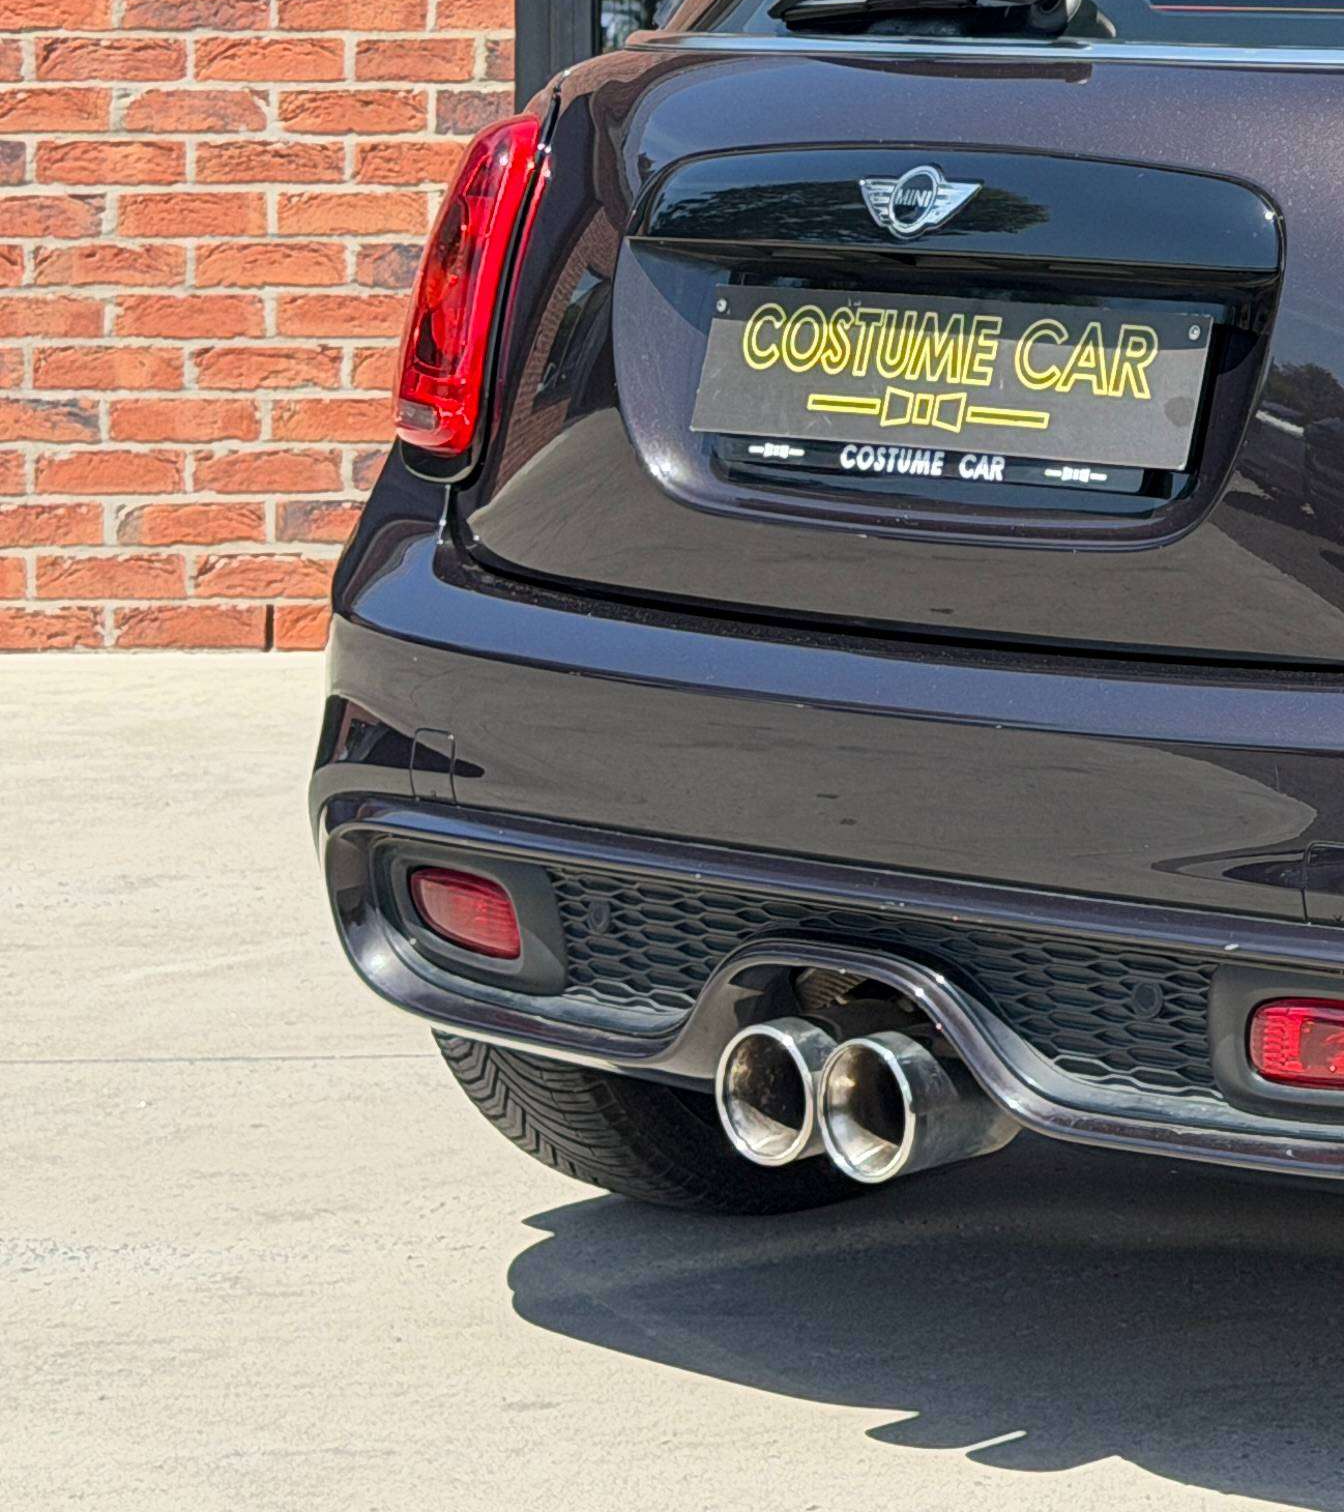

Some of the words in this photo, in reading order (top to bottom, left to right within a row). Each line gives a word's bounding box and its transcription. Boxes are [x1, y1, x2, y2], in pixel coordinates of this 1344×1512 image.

[894, 188, 932, 208] MINI
[742, 302, 1001, 387] COSTUME
[1013, 318, 1159, 399] CAR
[839, 444, 946, 477] COSTUME
[958, 453, 1006, 482] CAR
